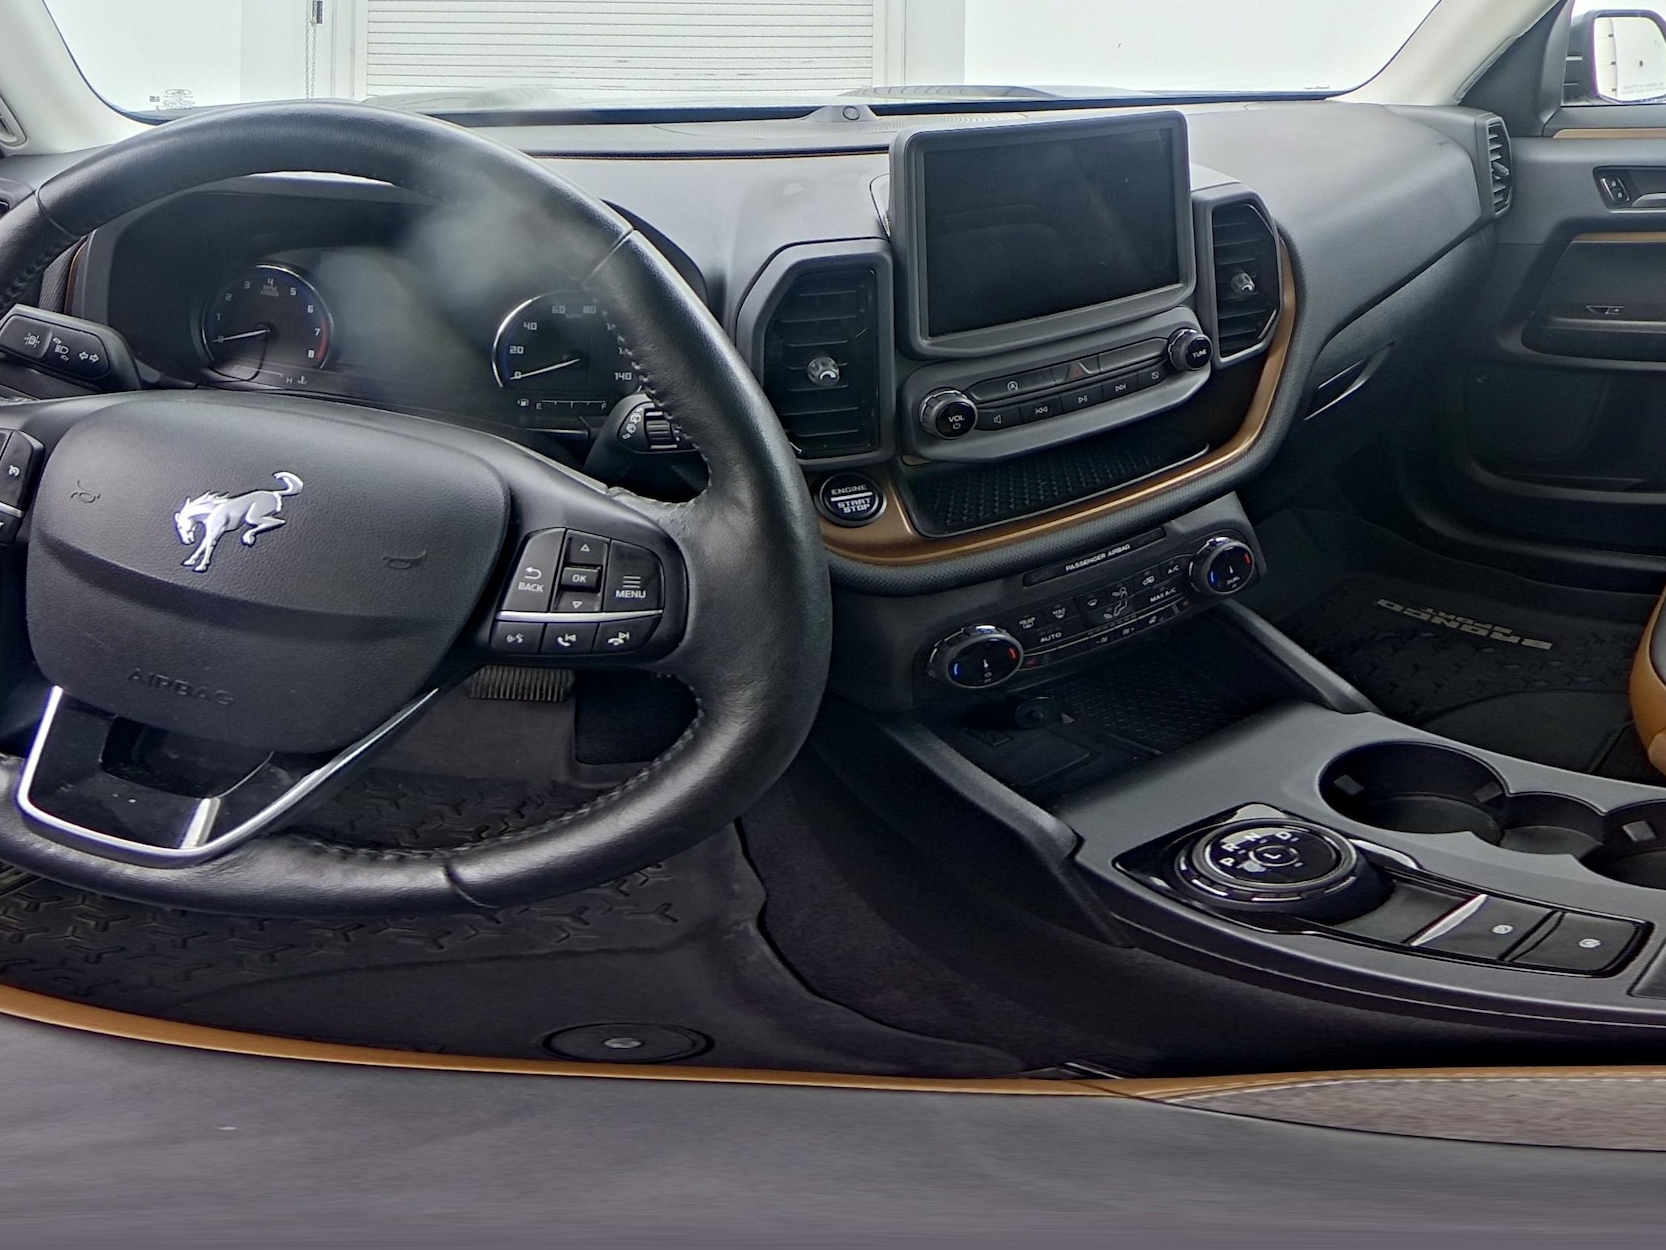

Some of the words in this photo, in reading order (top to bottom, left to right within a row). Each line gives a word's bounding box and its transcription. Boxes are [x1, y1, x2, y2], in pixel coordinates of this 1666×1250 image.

[267, 278, 274, 286] 4
[290, 287, 297, 296] 5
[225, 293, 232, 301] 2
[307, 305, 314, 313] 6
[551, 305, 566, 314] 60
[583, 305, 597, 314] 80
[523, 322, 538, 330] 40
[314, 328, 321, 336] 7
[307, 349, 315, 358] 8
[509, 345, 524, 354] 20
[1191, 349, 1207, 359] TUNE
[614, 372, 632, 381] 140
[948, 414, 965, 423] VOL
[831, 484, 868, 495] ENGINE
[837, 498, 871, 509] START
[843, 503, 871, 513] STOP
[1065, 552, 1107, 572] PASSENGER
[1107, 544, 1131, 560] AIRBAG
[1167, 564, 1180, 575] A/C
[572, 574, 587, 583] OK
[518, 582, 544, 592] BACK
[1164, 587, 1177, 597] A/C
[615, 590, 646, 599] MENU
[1376, 598, 1553, 650] BRONCO
[1040, 632, 1062, 643] AUTO
[128, 666, 234, 705] AIRBAG
[1244, 832, 1263, 842] N
[1275, 831, 1292, 841] D
[1221, 842, 1240, 852] R
[1219, 857, 1235, 867] P
